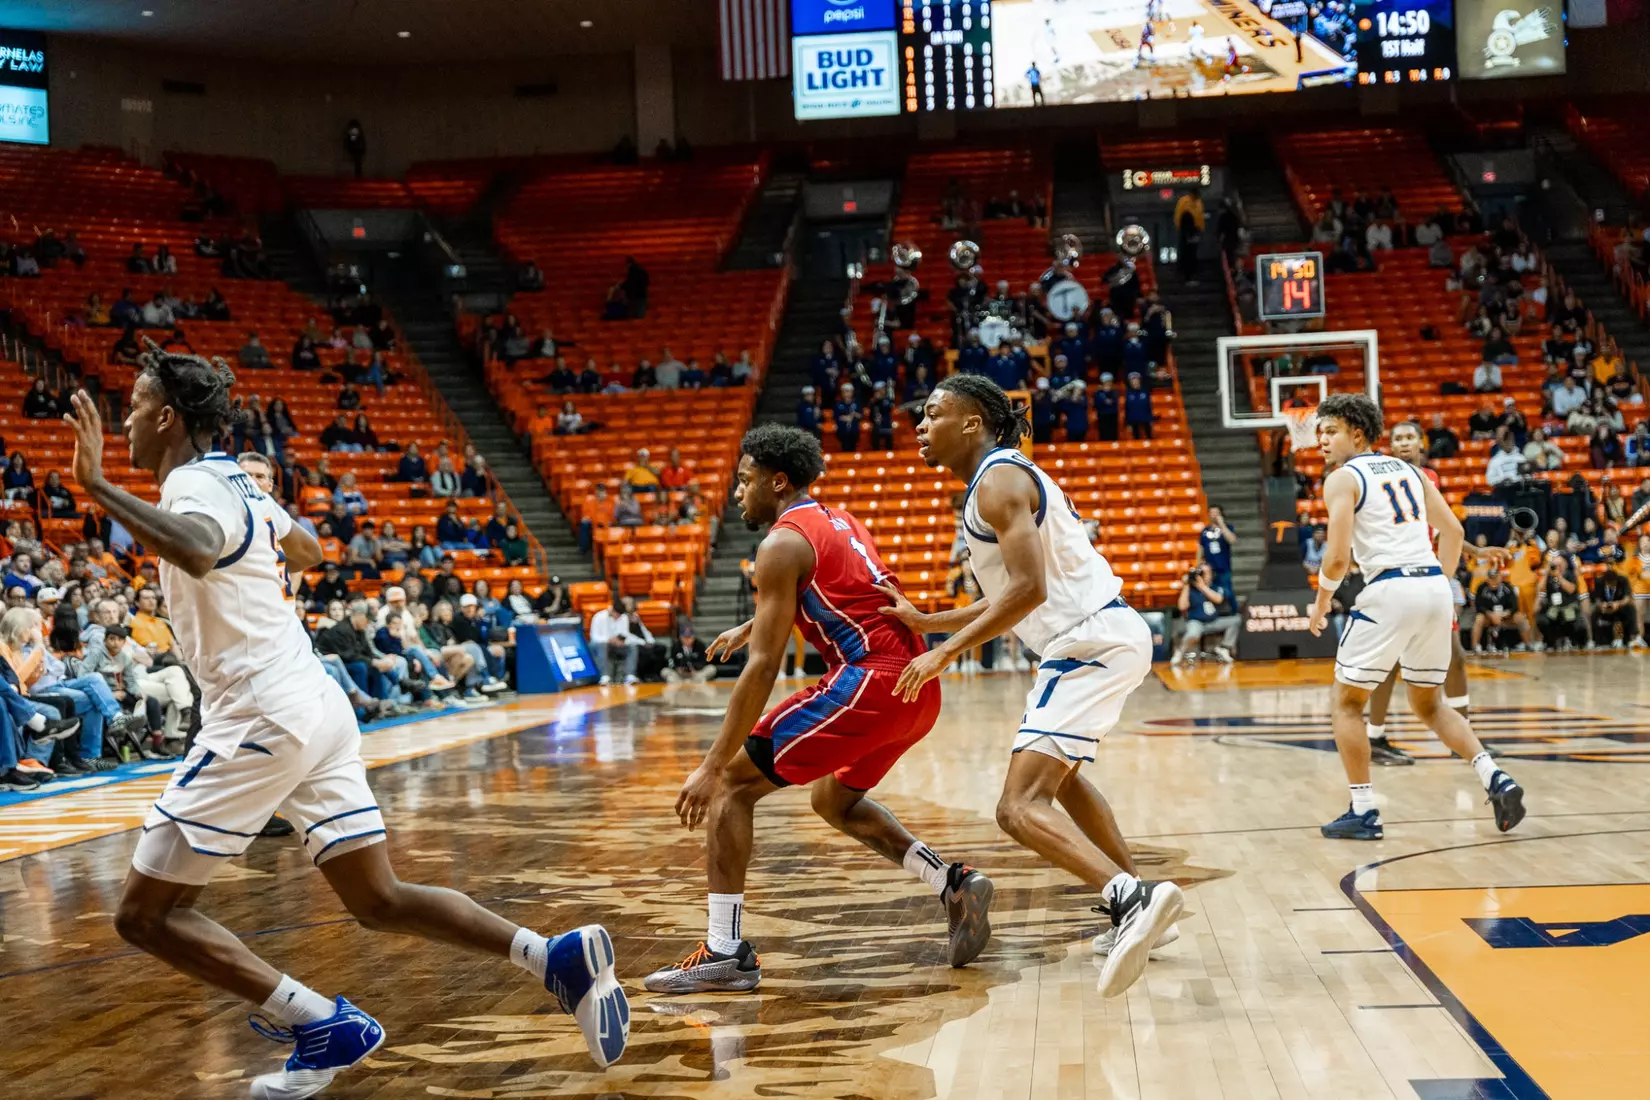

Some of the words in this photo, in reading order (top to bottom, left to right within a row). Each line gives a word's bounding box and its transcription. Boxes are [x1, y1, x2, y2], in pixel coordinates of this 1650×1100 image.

[823, 6, 865, 24] pepsi
[1376, 9, 1430, 37] 14:50
[10, 59, 44, 73] LAW
[818, 48, 873, 69] BUD
[806, 68, 885, 90] LIGHT
[1283, 280, 1312, 311] 14
[1381, 478, 1421, 525] 11
